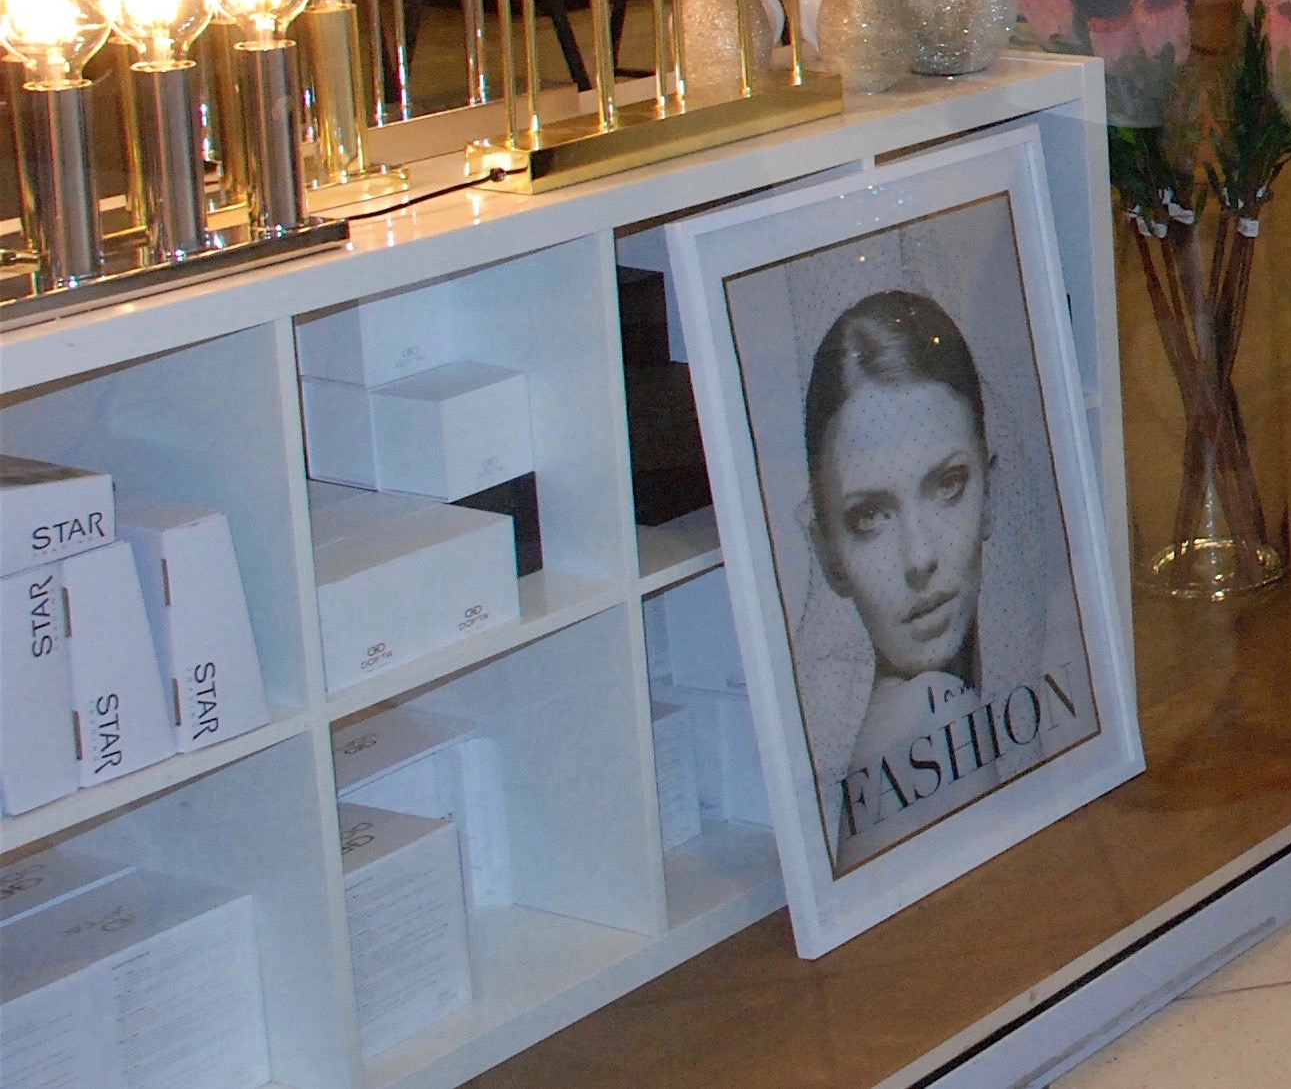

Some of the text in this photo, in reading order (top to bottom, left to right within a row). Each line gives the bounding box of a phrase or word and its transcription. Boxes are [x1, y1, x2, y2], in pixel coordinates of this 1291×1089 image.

[32, 512, 105, 550] STAR
[29, 575, 53, 657] STAR
[95, 693, 122, 774] STAR
[193, 662, 219, 740] STAR
[829, 661, 1077, 839] FASHION
